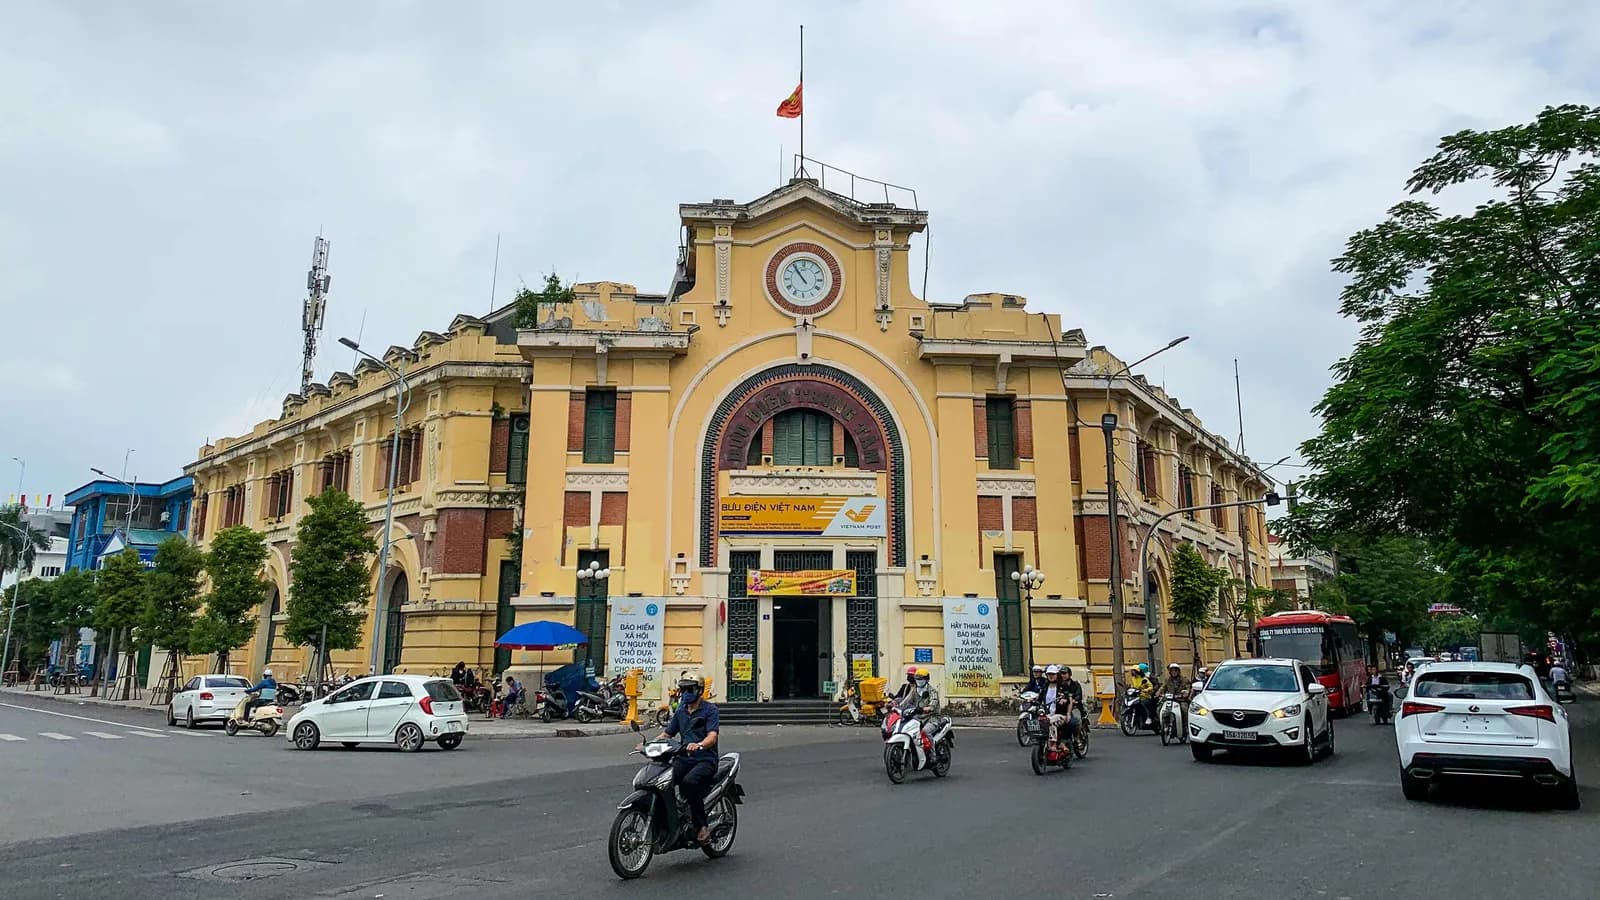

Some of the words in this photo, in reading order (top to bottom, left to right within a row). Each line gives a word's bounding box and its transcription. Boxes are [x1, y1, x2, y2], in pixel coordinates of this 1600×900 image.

[721, 502, 741, 511] BƯU
[744, 501, 767, 513] ĐIỆN
[770, 501, 791, 513] VIỆT
[793, 504, 815, 512] NAM
[620, 622, 635, 631] BẢO
[636, 623, 655, 631] HIỂM
[951, 622, 962, 630] HÃY
[636, 632, 649, 640] HỘI
[957, 630, 970, 638] BẢO
[616, 640, 626, 648] TỰ
[628, 640, 657, 648] NGUYỆN
[970, 639, 982, 647] HỘI
[964, 647, 989, 655] NGUYỆN
[958, 655, 975, 664] CUỘC
[976, 655, 993, 663] SỐNG
[959, 673, 975, 681] HẠNH
[976, 672, 993, 680] PHÚC
